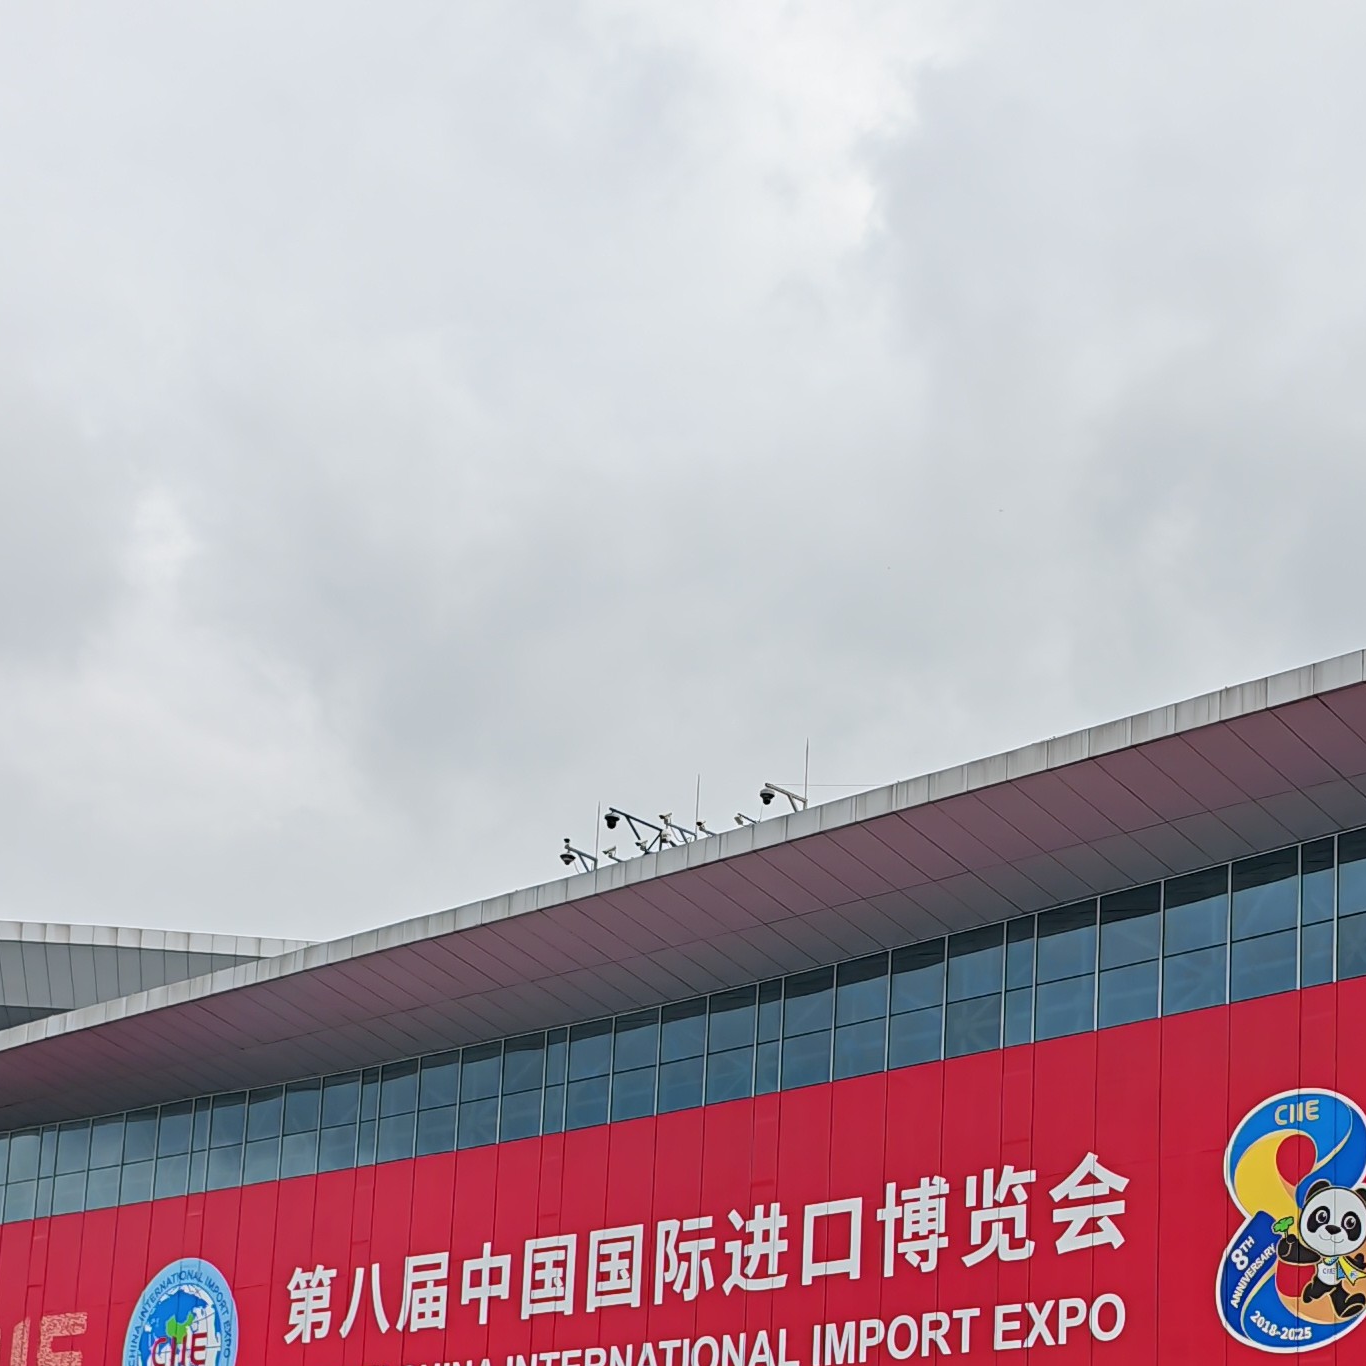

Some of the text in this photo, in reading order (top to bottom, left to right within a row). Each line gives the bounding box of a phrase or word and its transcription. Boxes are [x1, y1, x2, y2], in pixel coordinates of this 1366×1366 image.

[1274, 1099, 1320, 1126] CIIE
[284, 1152, 1130, 1345] 第八届中国国际进口博览会
[1230, 1243, 1276, 1309] ANNIVERSARY
[1231, 1235, 1255, 1271] 8TH
[139, 1269, 204, 1323] INTERNATIONAL
[205, 1275, 230, 1316] IMPORT
[223, 1320, 233, 1359] EXPO
[812, 1307, 980, 1366] IMPORT
[994, 1293, 1126, 1351] EXPO
[1250, 1310, 1313, 1341] 2018-2025
